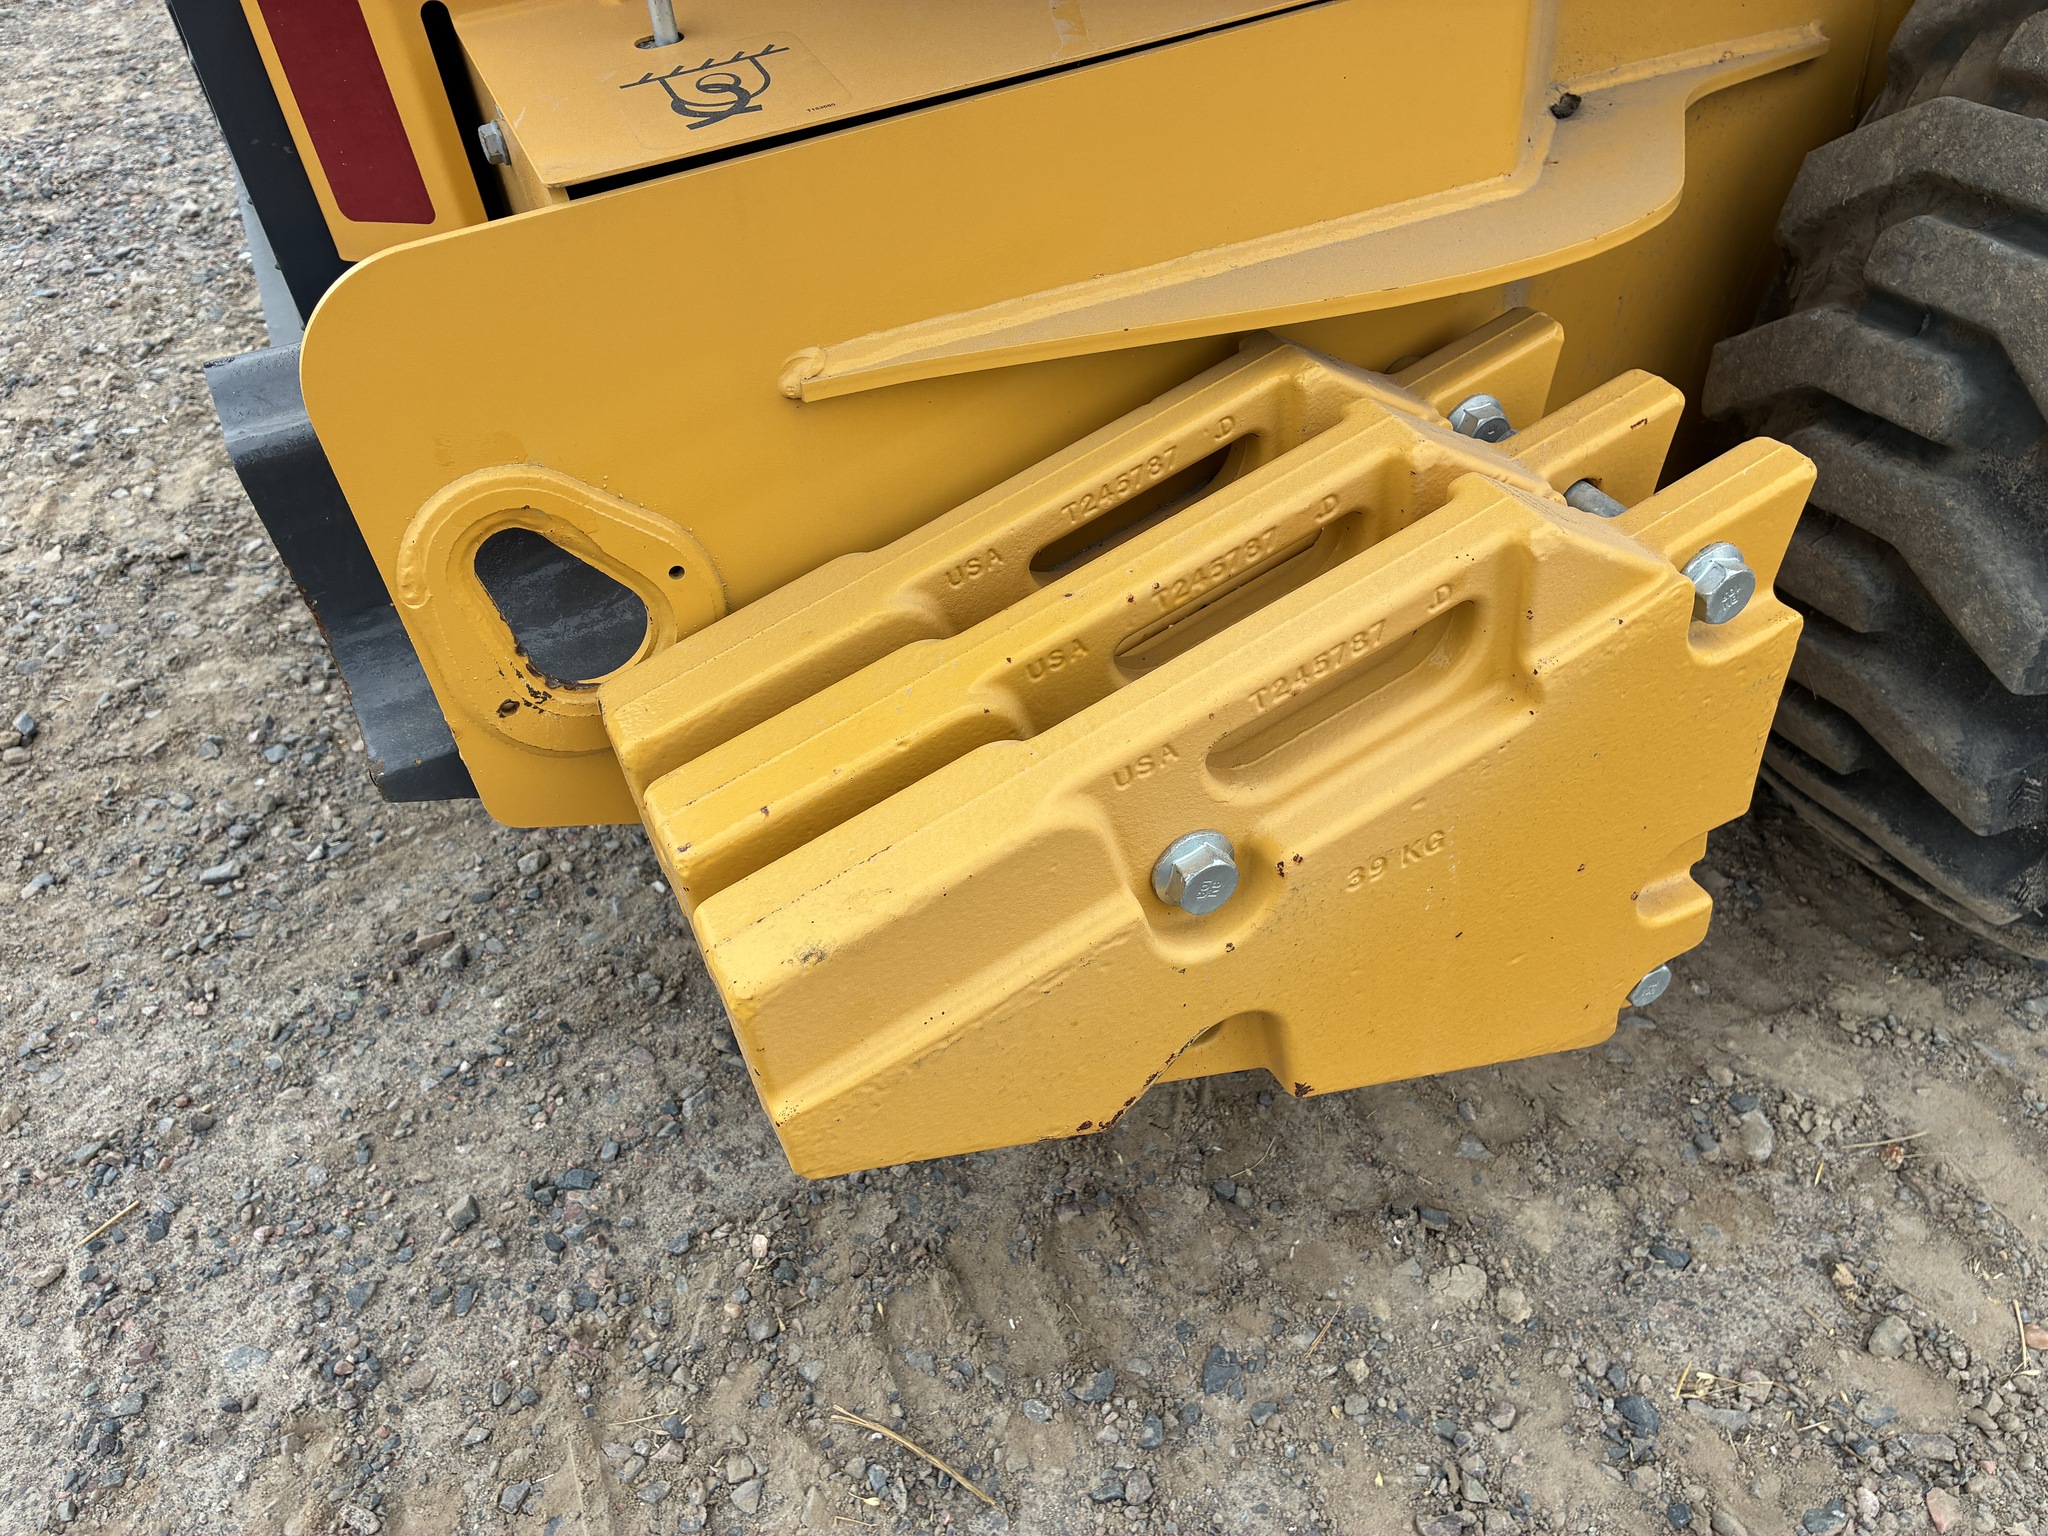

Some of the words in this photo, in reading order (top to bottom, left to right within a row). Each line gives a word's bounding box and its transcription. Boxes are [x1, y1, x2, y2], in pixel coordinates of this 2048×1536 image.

[945, 547, 1004, 590] USA
[1060, 445, 1178, 525] T245787
[1023, 637, 1089, 683] USA
[1150, 525, 1279, 611] T245787
[1111, 742, 1180, 792] USA
[1248, 618, 1388, 715] T245787
[1345, 856, 1389, 893] 39
[1399, 828, 1448, 869] KG
